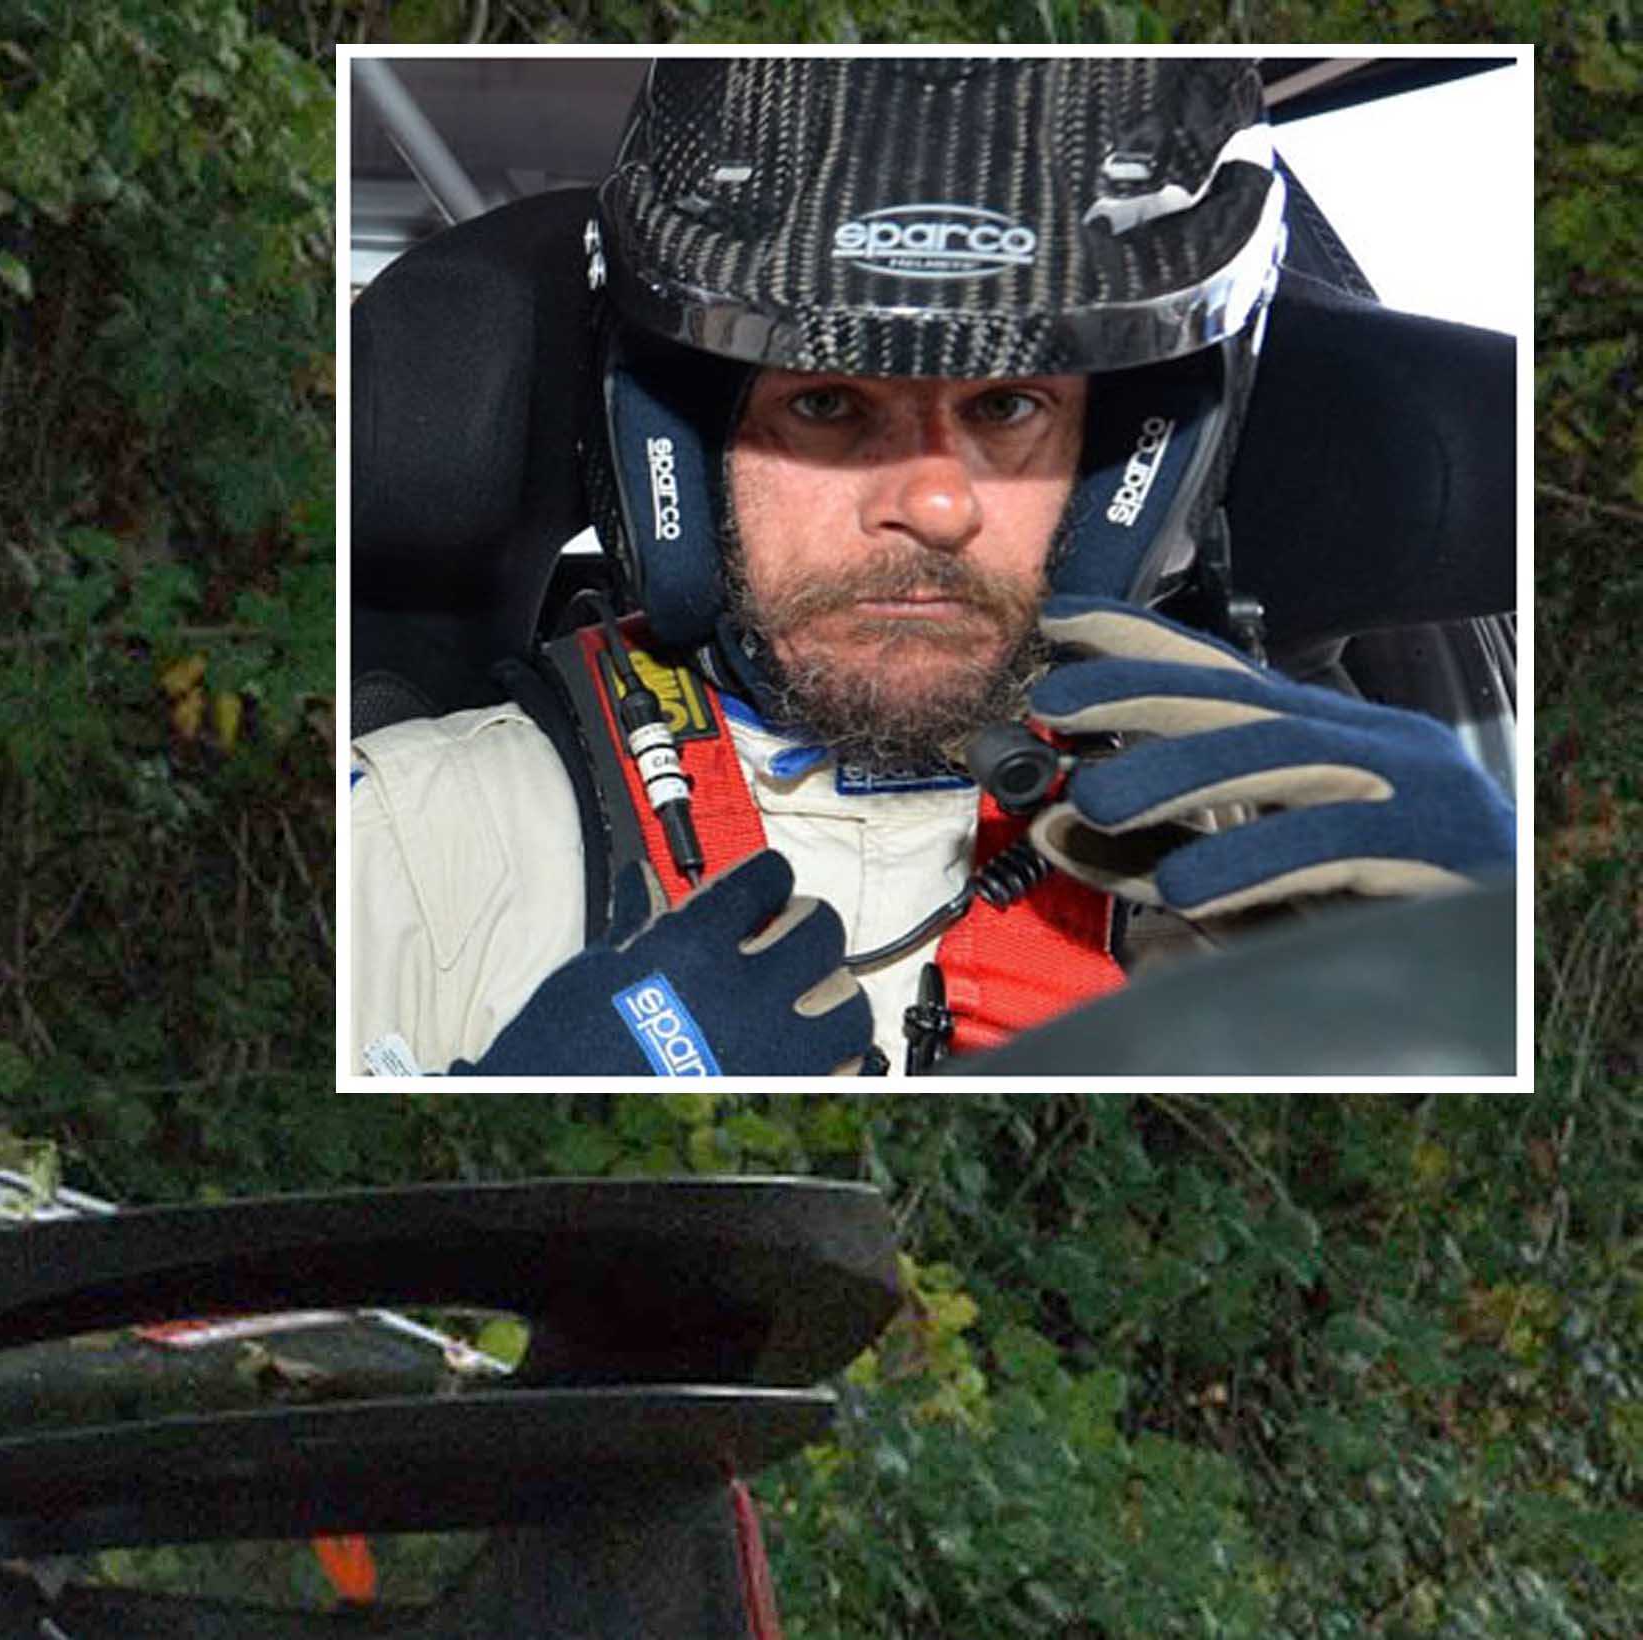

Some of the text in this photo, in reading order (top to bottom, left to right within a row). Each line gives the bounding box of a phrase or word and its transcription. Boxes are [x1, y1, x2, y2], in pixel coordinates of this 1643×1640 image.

[834, 221, 1037, 264] sparco
[646, 437, 681, 541] sparco
[1106, 416, 1176, 526] sparco
